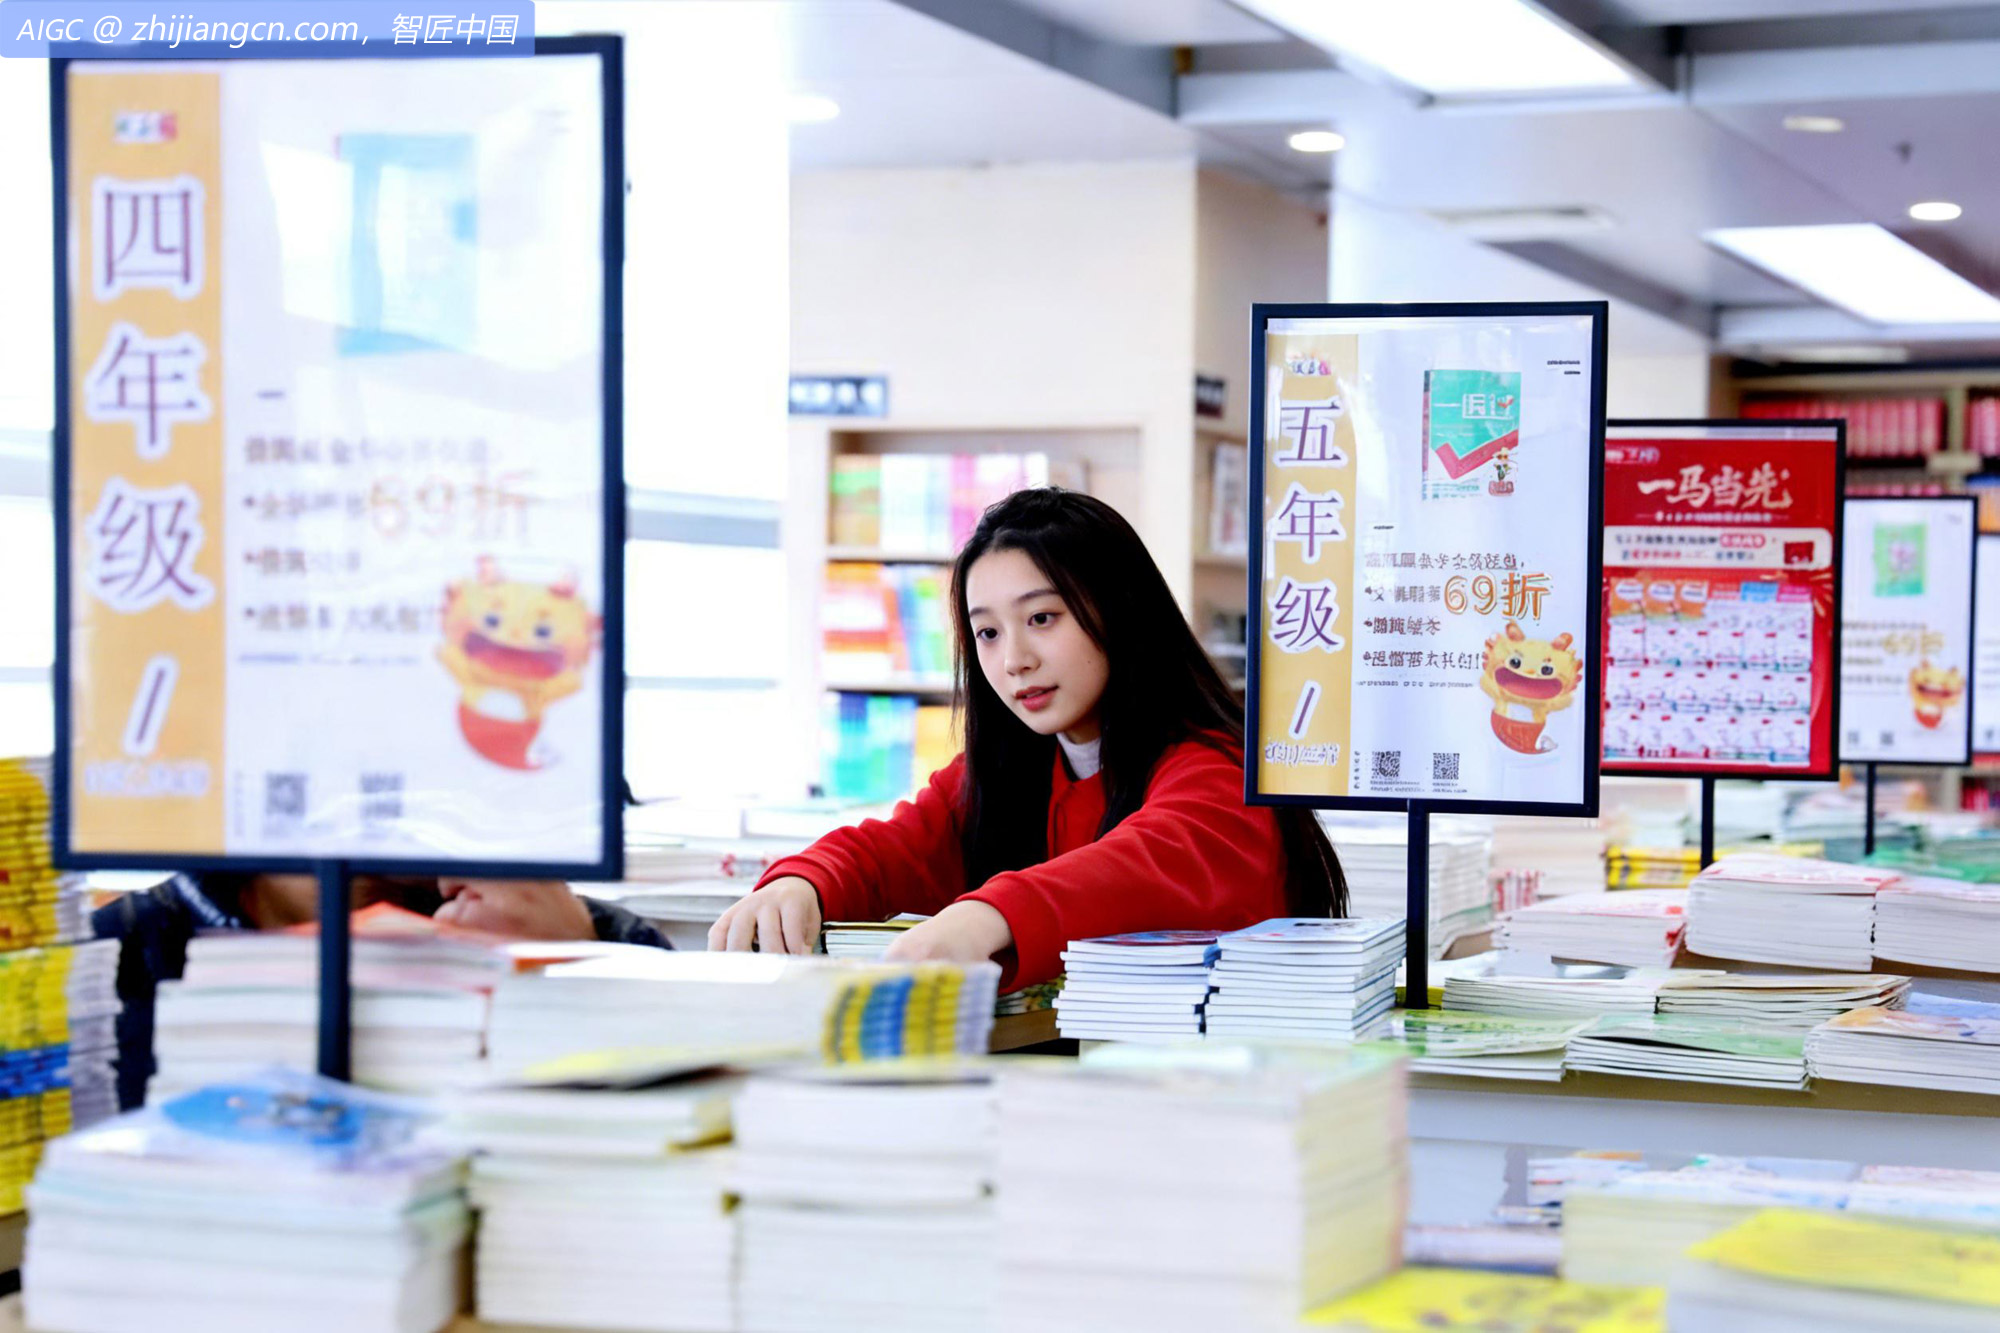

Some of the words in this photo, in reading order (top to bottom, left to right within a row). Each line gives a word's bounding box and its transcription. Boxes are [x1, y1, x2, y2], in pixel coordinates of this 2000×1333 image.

[1637, 461, 1794, 509] 一马当先
[1443, 571, 1553, 621] 69折
